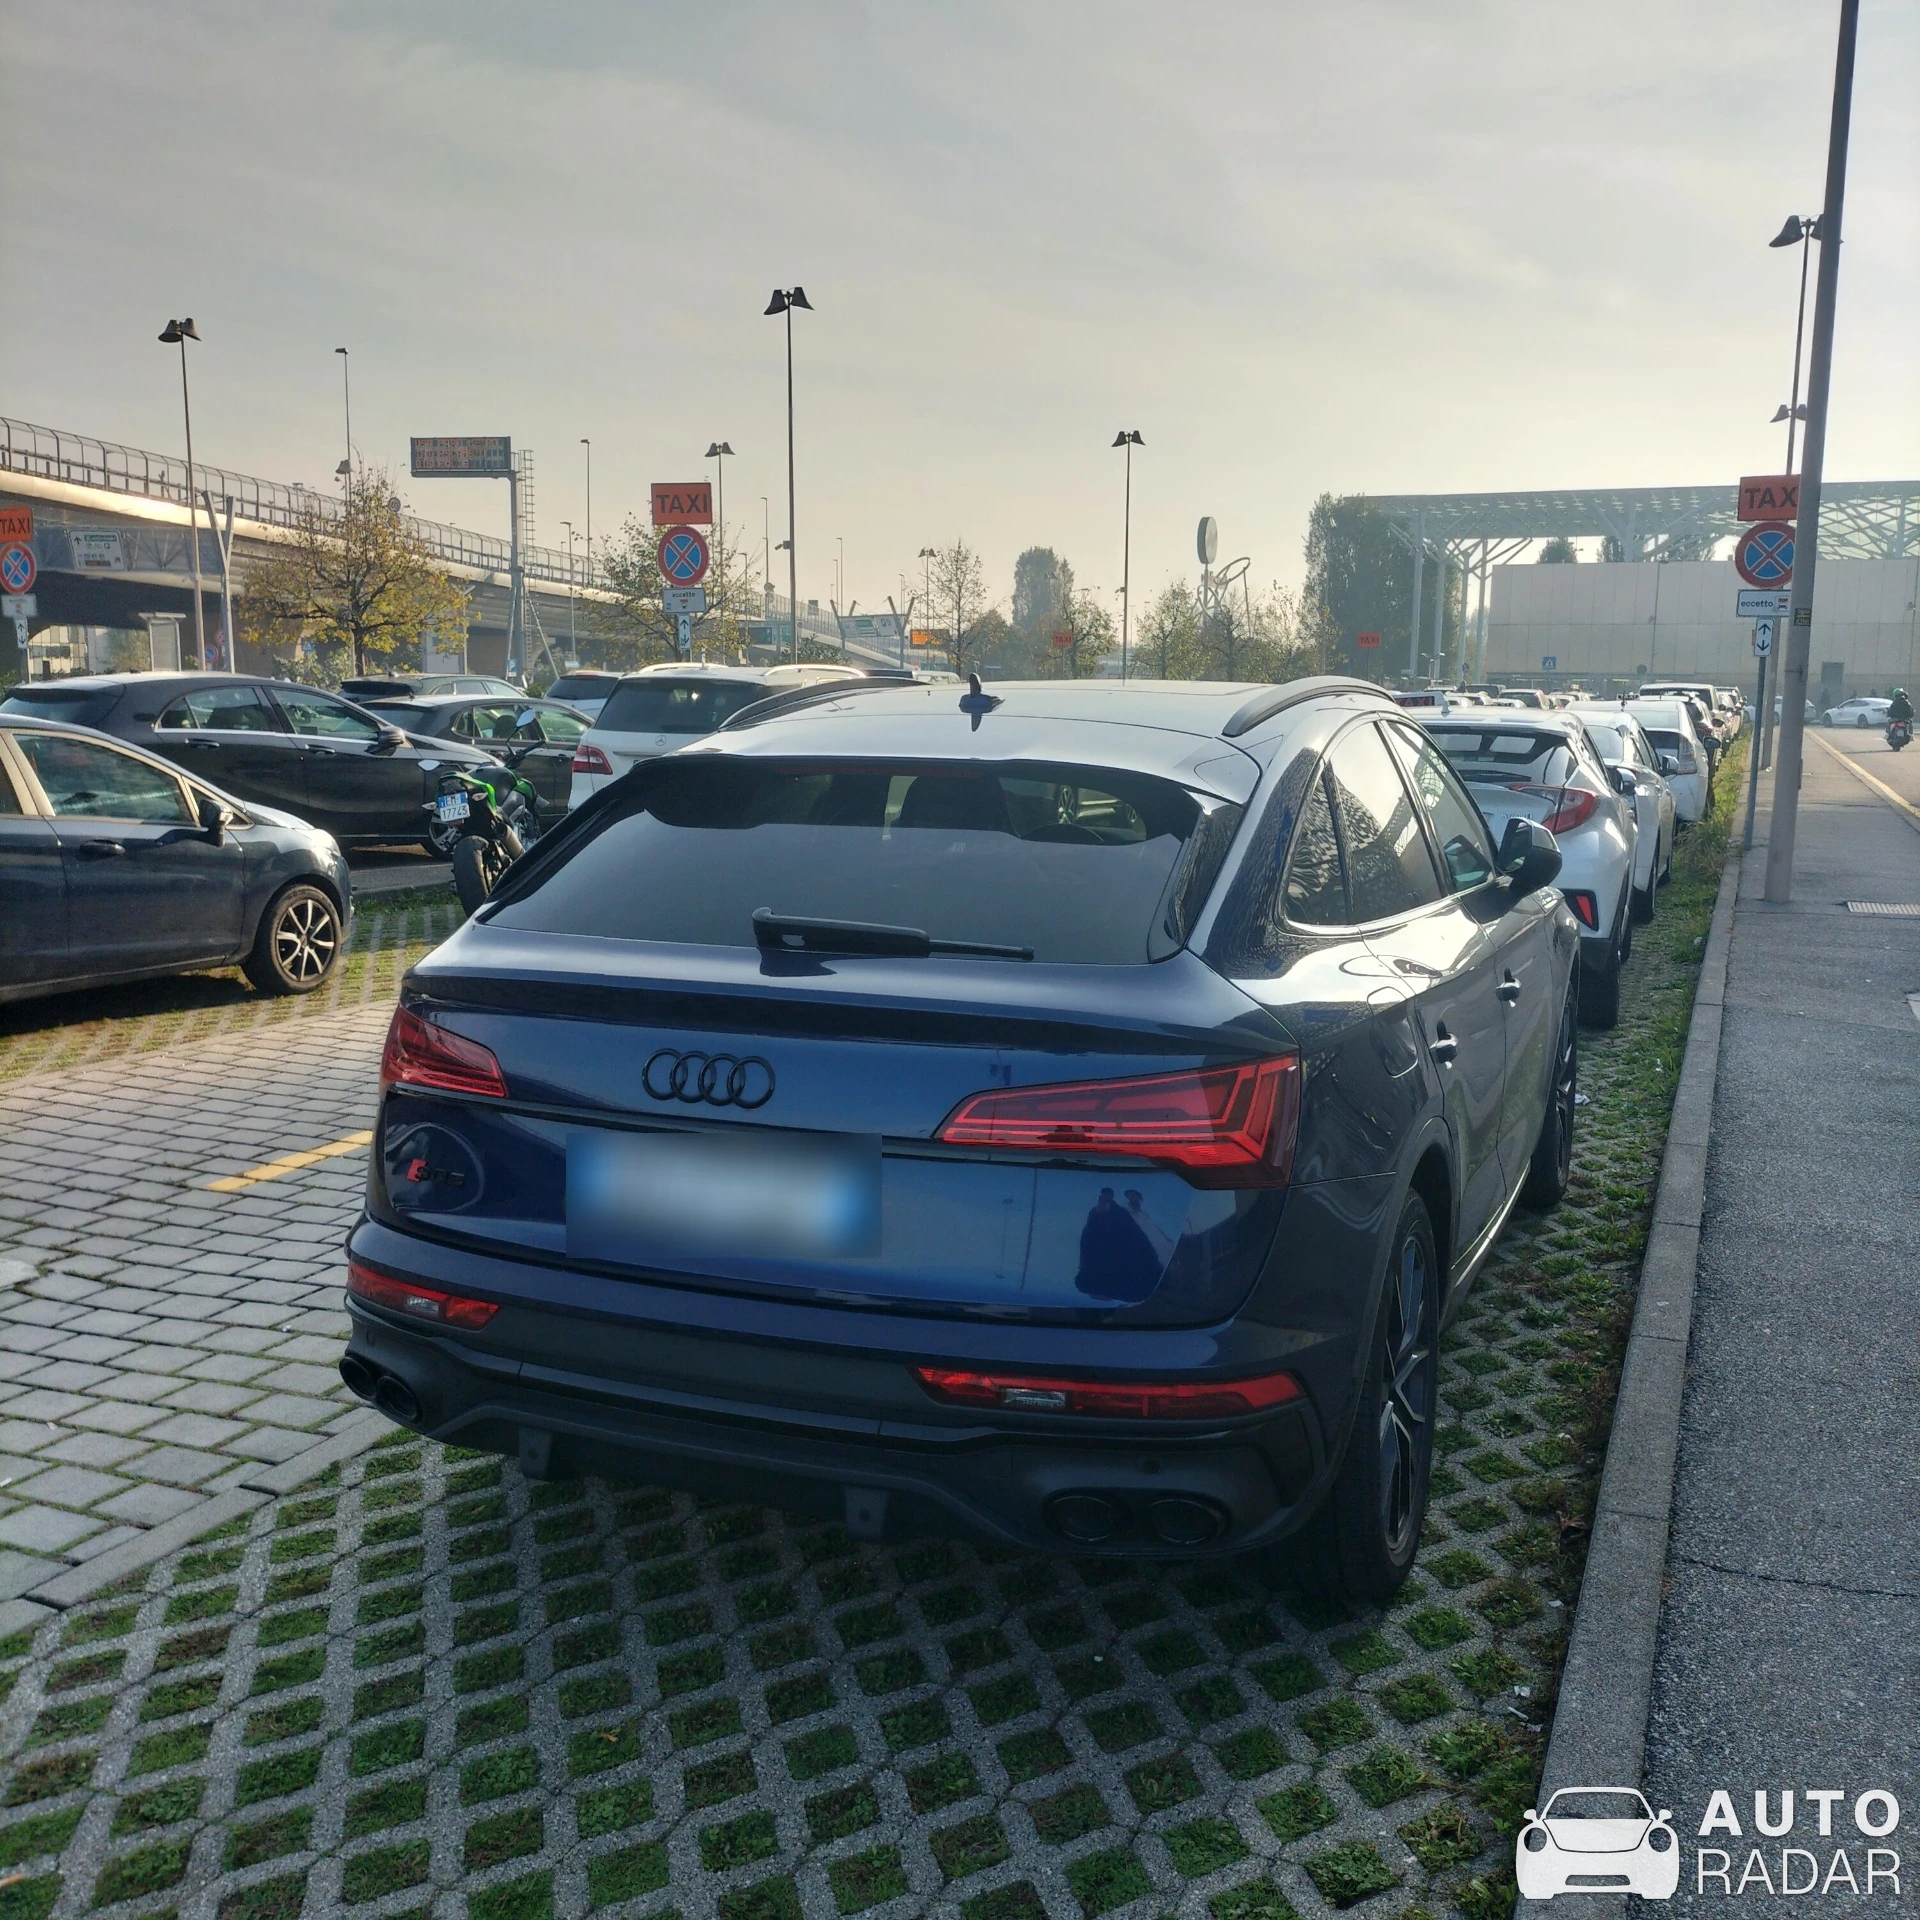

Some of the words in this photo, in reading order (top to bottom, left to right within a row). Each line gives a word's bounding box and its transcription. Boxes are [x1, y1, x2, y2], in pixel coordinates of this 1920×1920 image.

[656, 493, 709, 514] TAXI
[1744, 486, 1798, 509] TAX
[0, 517, 30, 535] TAXI
[1740, 599, 1774, 608] eccetto
[1358, 636, 1379, 644] TAXI
[442, 806, 467, 819] 17743
